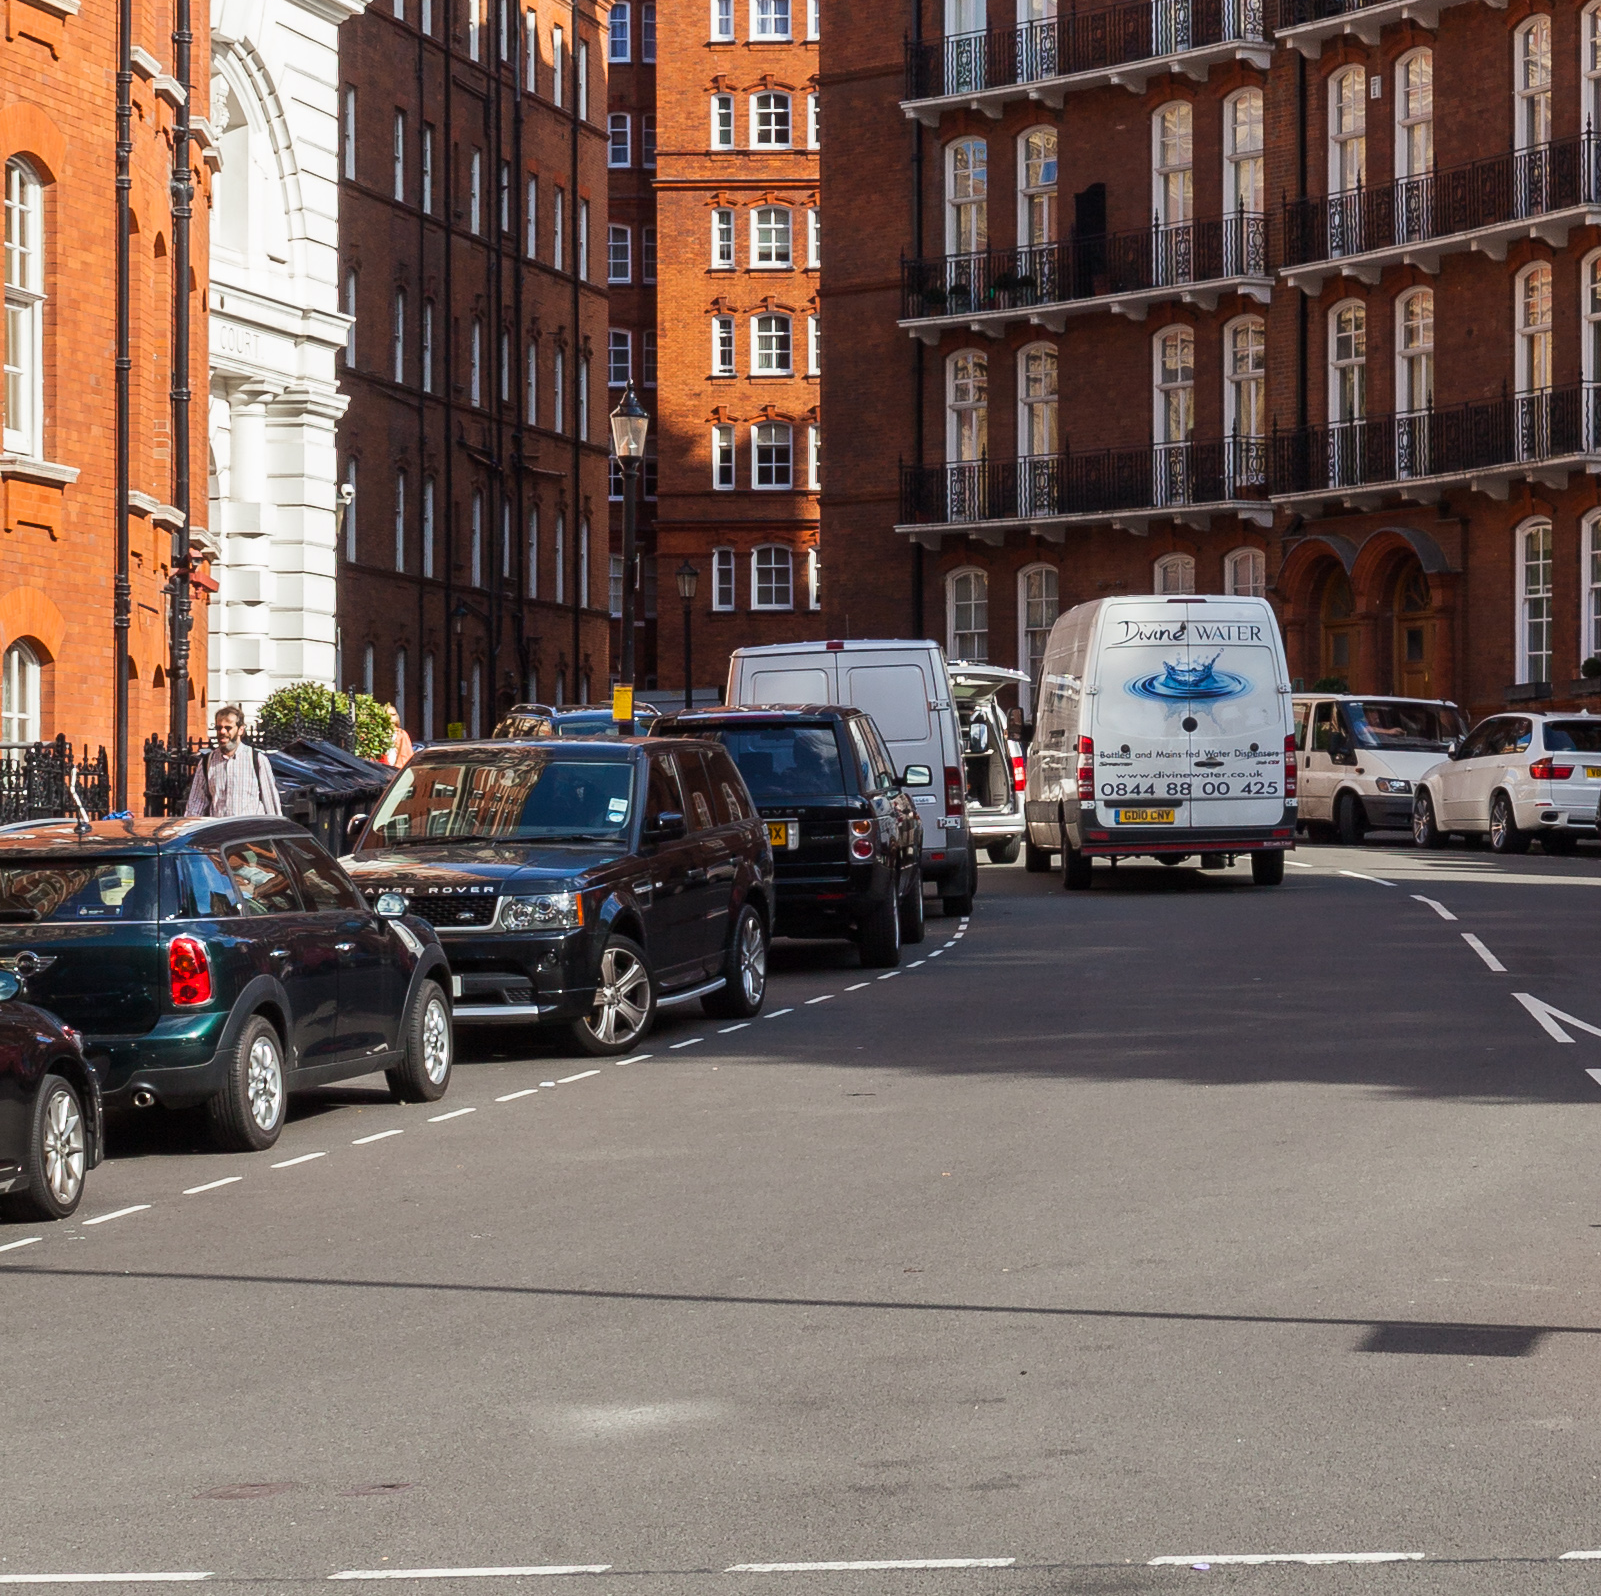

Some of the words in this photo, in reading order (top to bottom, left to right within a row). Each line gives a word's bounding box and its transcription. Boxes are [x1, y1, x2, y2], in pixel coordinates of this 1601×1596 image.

[1112, 620, 1187, 646] Divine
[1195, 625, 1262, 642] WATER
[1100, 750, 1131, 759] Bottled
[1135, 750, 1152, 759] and
[1156, 750, 1200, 759] Mains-fed
[1204, 749, 1230, 758] Water
[1234, 748, 1279, 759] Dispensers
[1116, 770, 1263, 779] www.divinewater.co.uk
[1101, 782, 1155, 796] 0844
[1166, 782, 1191, 796] 88
[1202, 781, 1230, 796] 00
[1240, 781, 1278, 795] 425
[1150, 810, 1171, 821] CNY
[428, 886, 494, 894] ROVER
